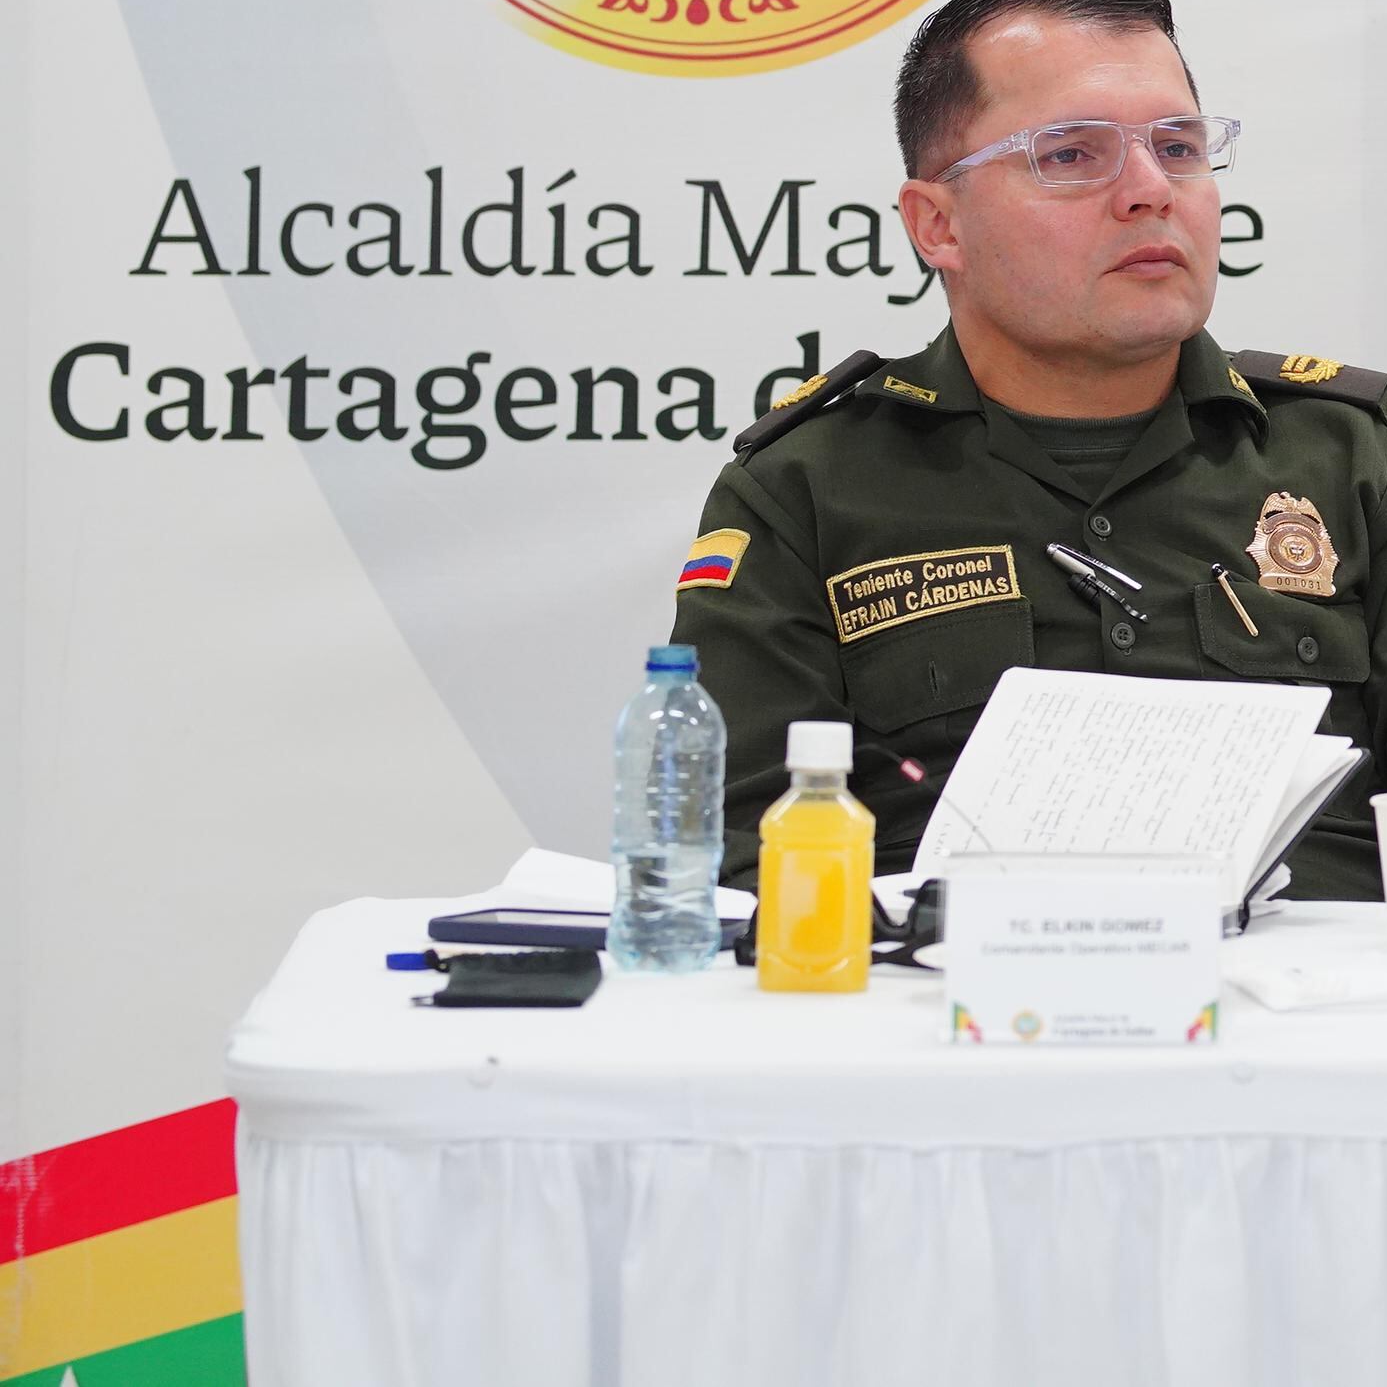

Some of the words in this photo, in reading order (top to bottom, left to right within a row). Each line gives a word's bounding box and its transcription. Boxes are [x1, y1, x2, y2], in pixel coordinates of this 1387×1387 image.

[128, 166, 655, 277] Alcaldía
[1218, 203, 1263, 277] e
[50, 342, 728, 471] Cartagena
[754, 330, 820, 422] d
[840, 596, 898, 633] EFRAIN
[905, 576, 1010, 611] CÁRDENAS
[843, 568, 914, 602] Teniente
[922, 555, 992, 581] Coronel
[1276, 576, 1322, 591] 001031
